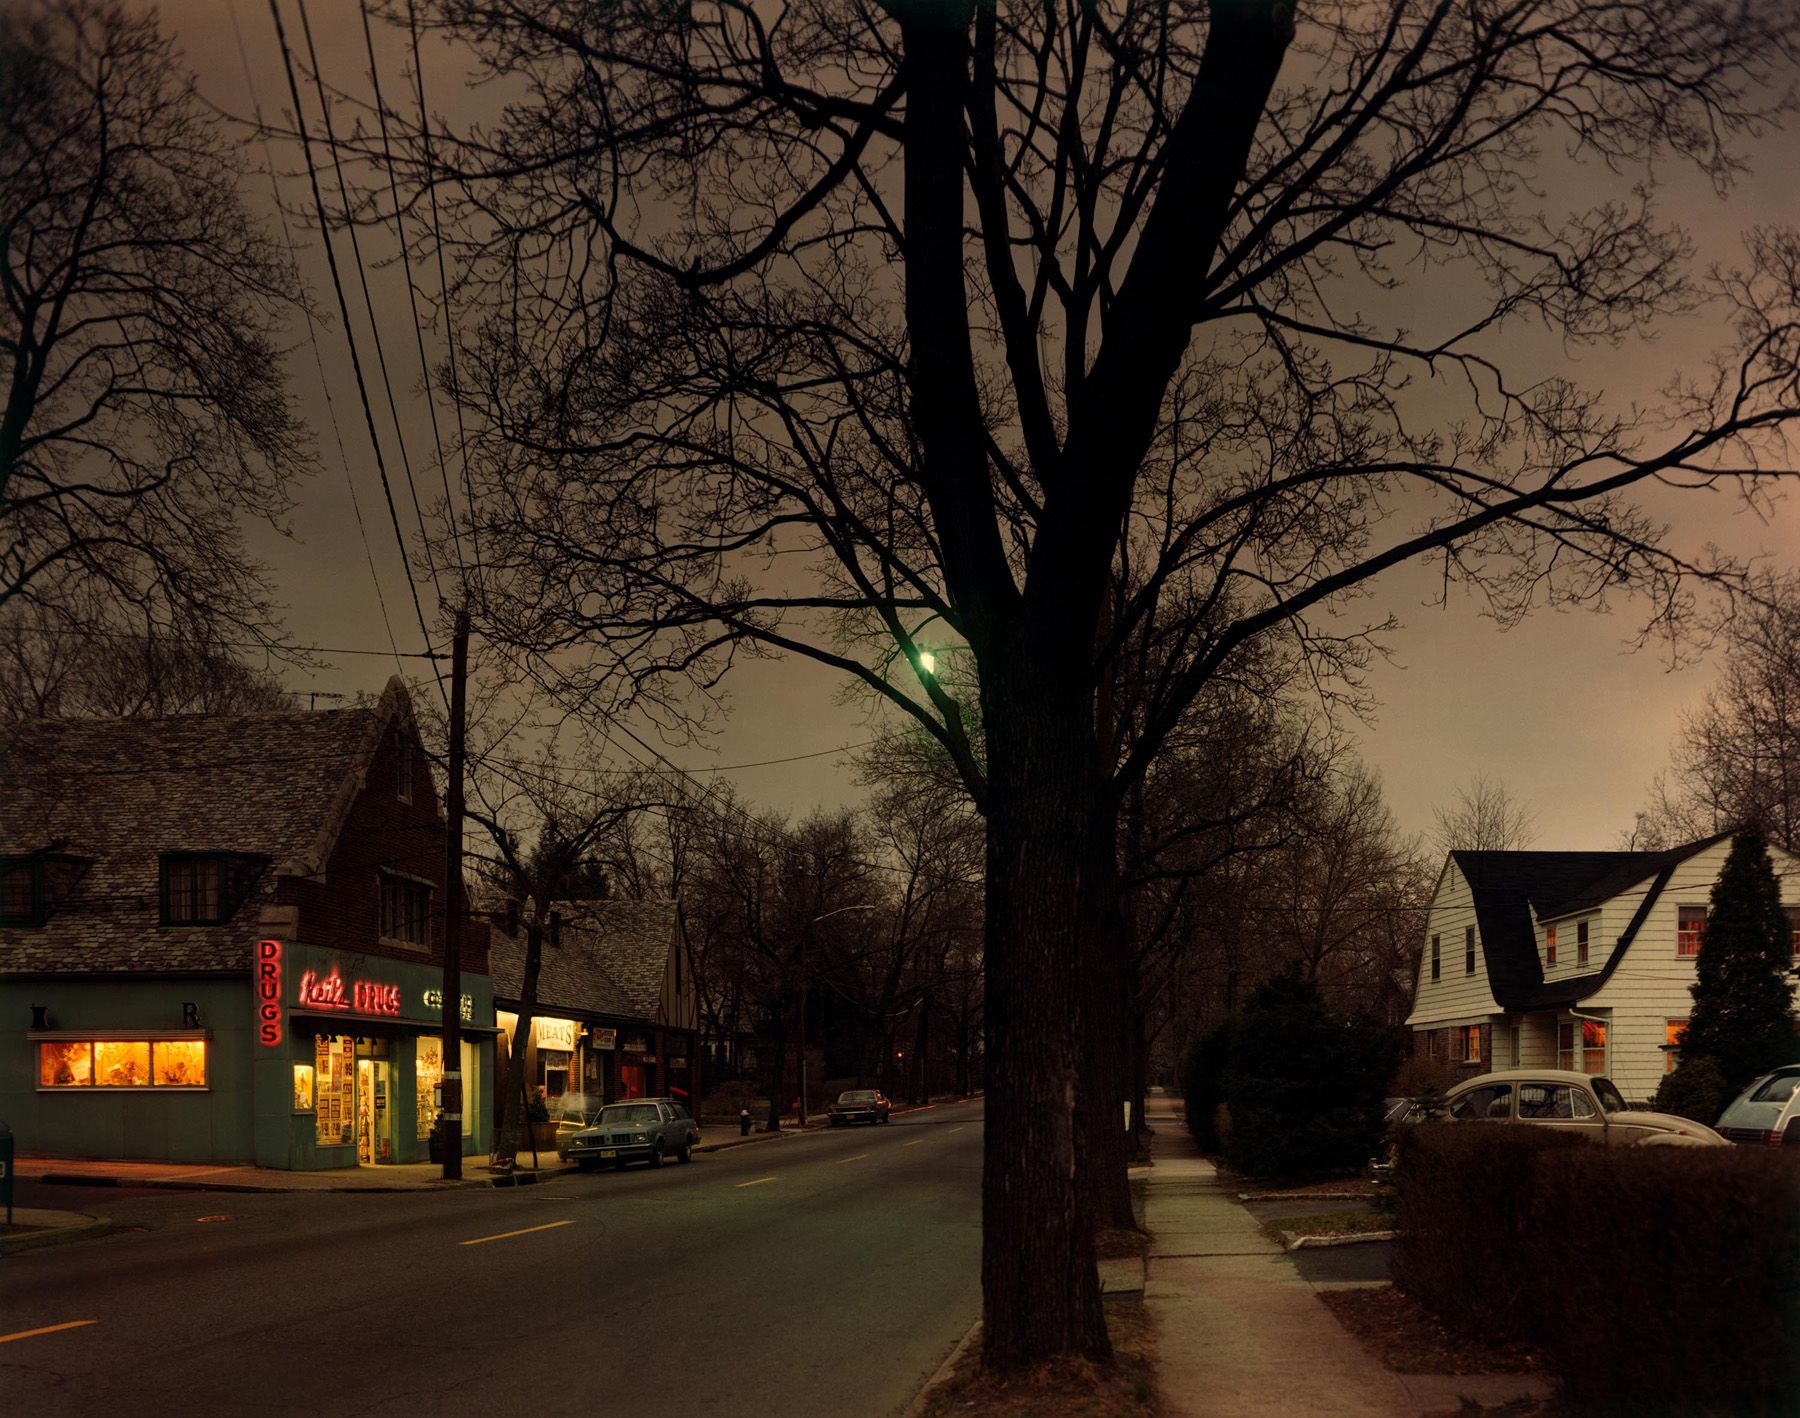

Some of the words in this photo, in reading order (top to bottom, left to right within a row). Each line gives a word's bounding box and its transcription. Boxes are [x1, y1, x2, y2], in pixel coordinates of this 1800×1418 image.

[260, 942, 278, 1042] DRUGS
[354, 981, 401, 1015] DRUGS
[536, 1019, 573, 1045] MEATS
